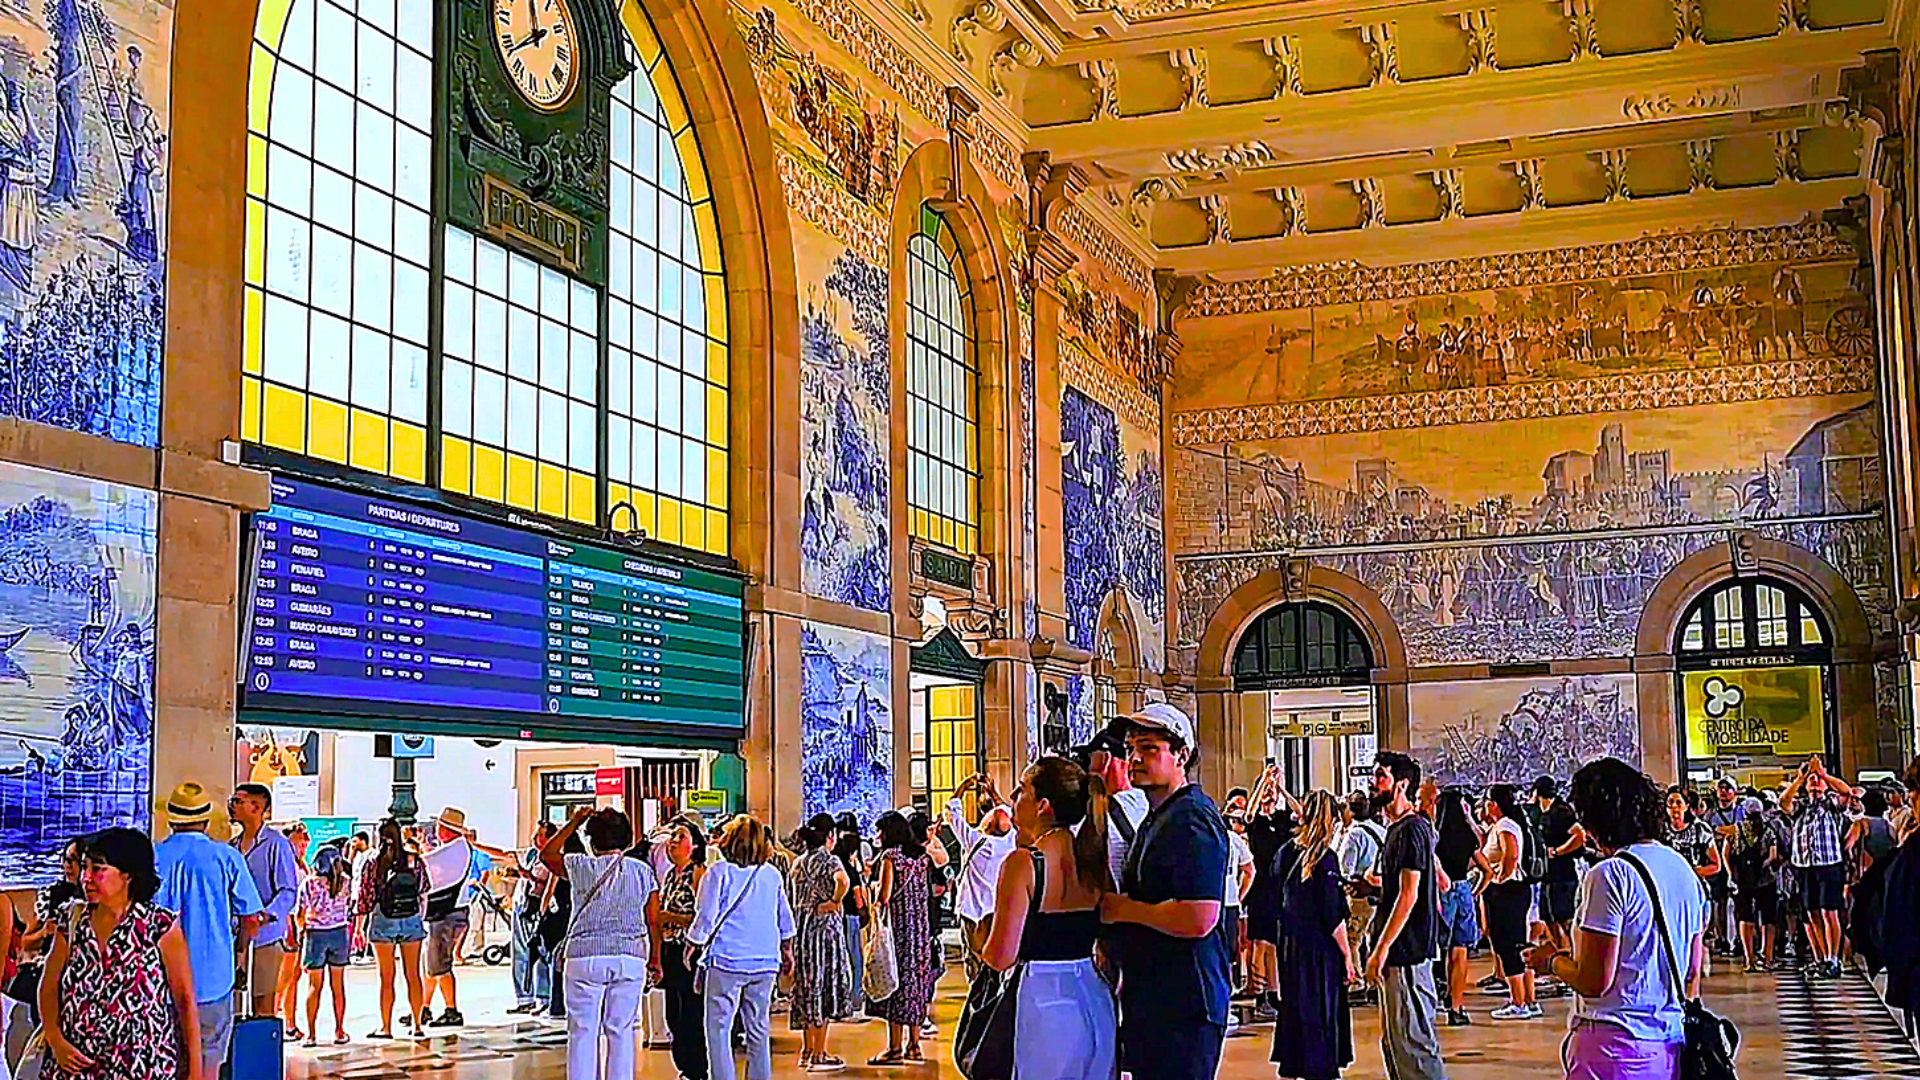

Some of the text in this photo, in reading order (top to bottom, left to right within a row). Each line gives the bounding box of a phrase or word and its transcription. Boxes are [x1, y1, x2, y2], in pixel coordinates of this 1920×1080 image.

[368, 504, 407, 522] PARTIDAS
[411, 513, 460, 533] DEPARTURES
[292, 526, 318, 539] BRAGA
[291, 545, 319, 558] AVEIRO
[290, 583, 317, 595] BRAGA
[289, 639, 316, 652] BRAGA
[288, 659, 316, 670] AVEIRO
[1698, 718, 1766, 734] CENTRO DA
[1706, 729, 1789, 745] MOBILIDADE
